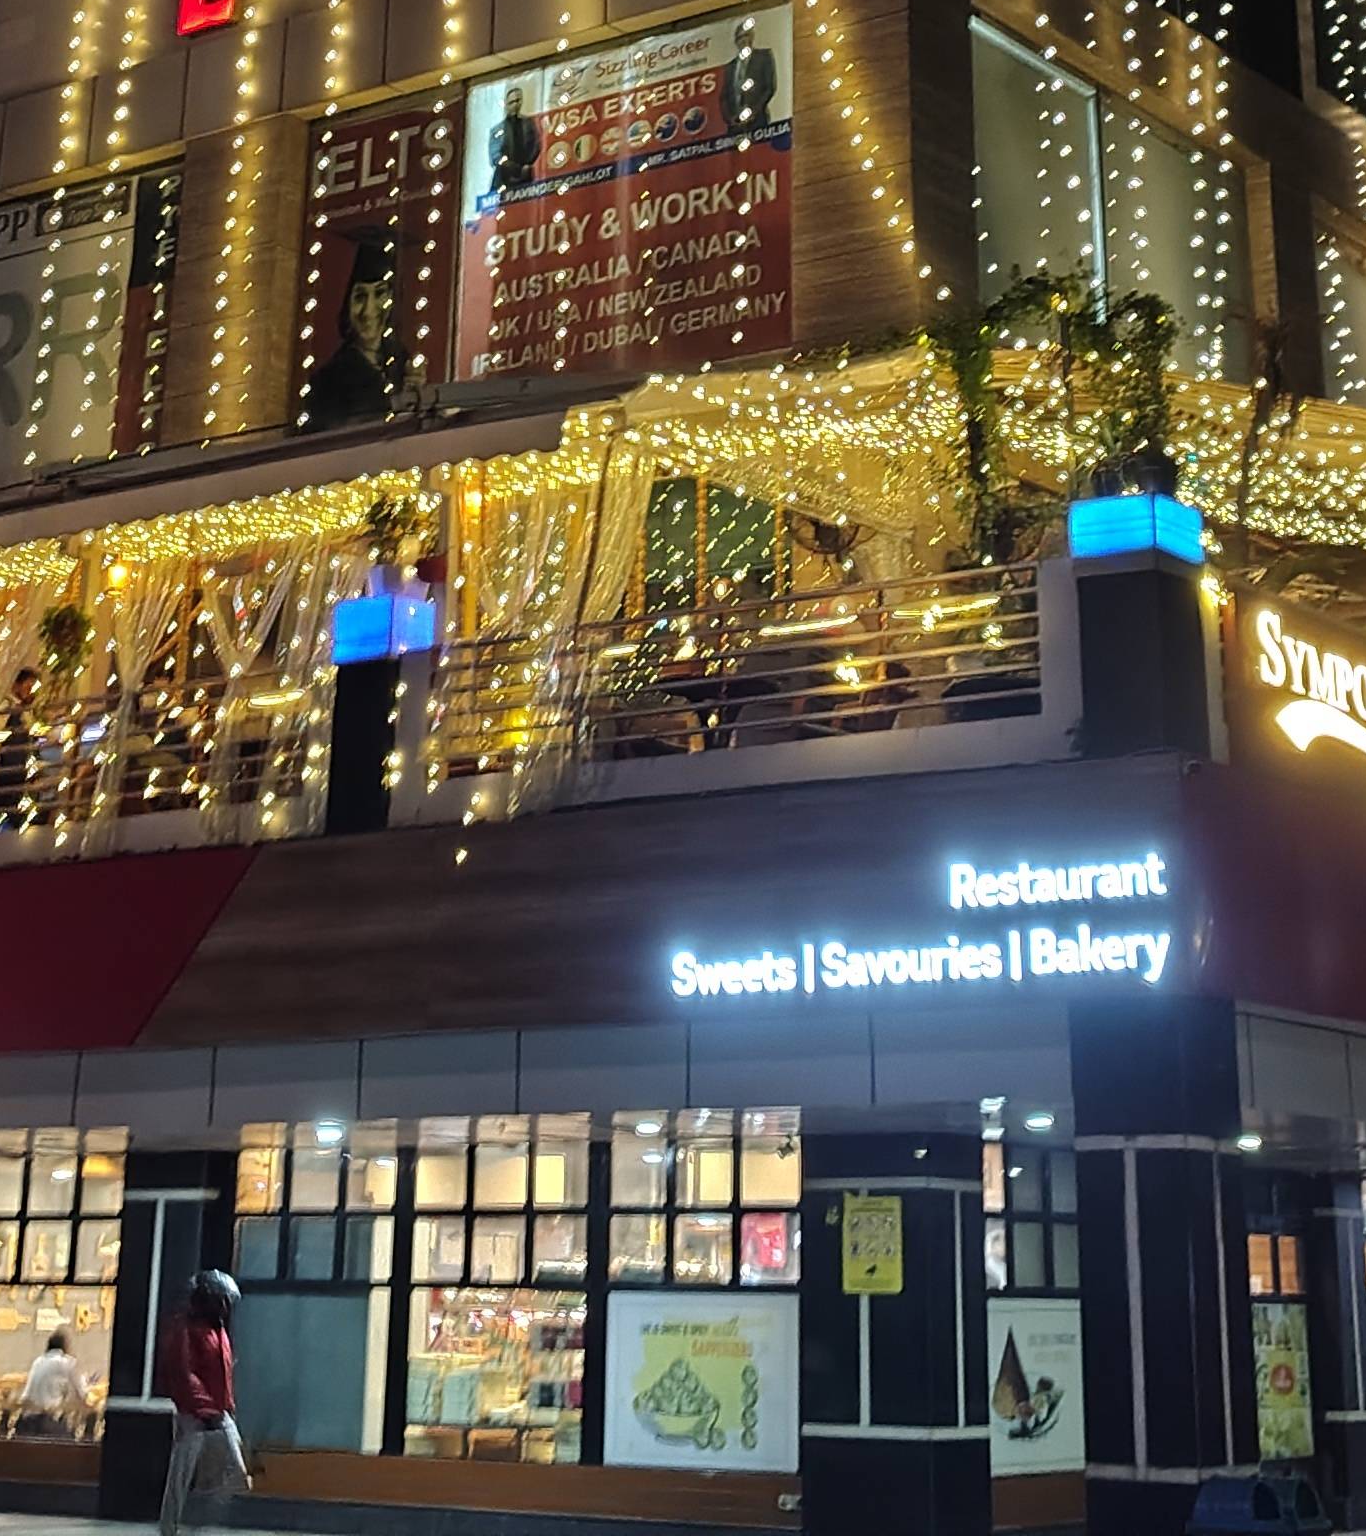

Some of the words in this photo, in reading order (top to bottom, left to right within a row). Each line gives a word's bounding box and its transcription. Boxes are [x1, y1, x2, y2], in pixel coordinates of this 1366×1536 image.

[542, 104, 598, 136] VISA
[604, 74, 717, 120] EXPERTS
[311, 119, 454, 201] IELTS
[485, 214, 592, 267] STUDY
[601, 207, 621, 240] &
[632, 180, 735, 231] WORK
[743, 169, 778, 206] IN
[492, 316, 521, 342] UK
[538, 302, 582, 331] USA
[597, 284, 652, 319] NEW
[653, 264, 762, 305] ZEALAND
[496, 254, 632, 305] AUSTRALIA
[650, 225, 762, 268] CANADA
[471, 344, 567, 377] IRELAND
[584, 321, 654, 353] DUBAI
[669, 290, 786, 335] GERMANY
[949, 853, 1168, 909] Restaurant
[671, 950, 797, 996] Sweets
[821, 934, 1003, 989] Savouries
[1029, 923, 1171, 984] Bakery
